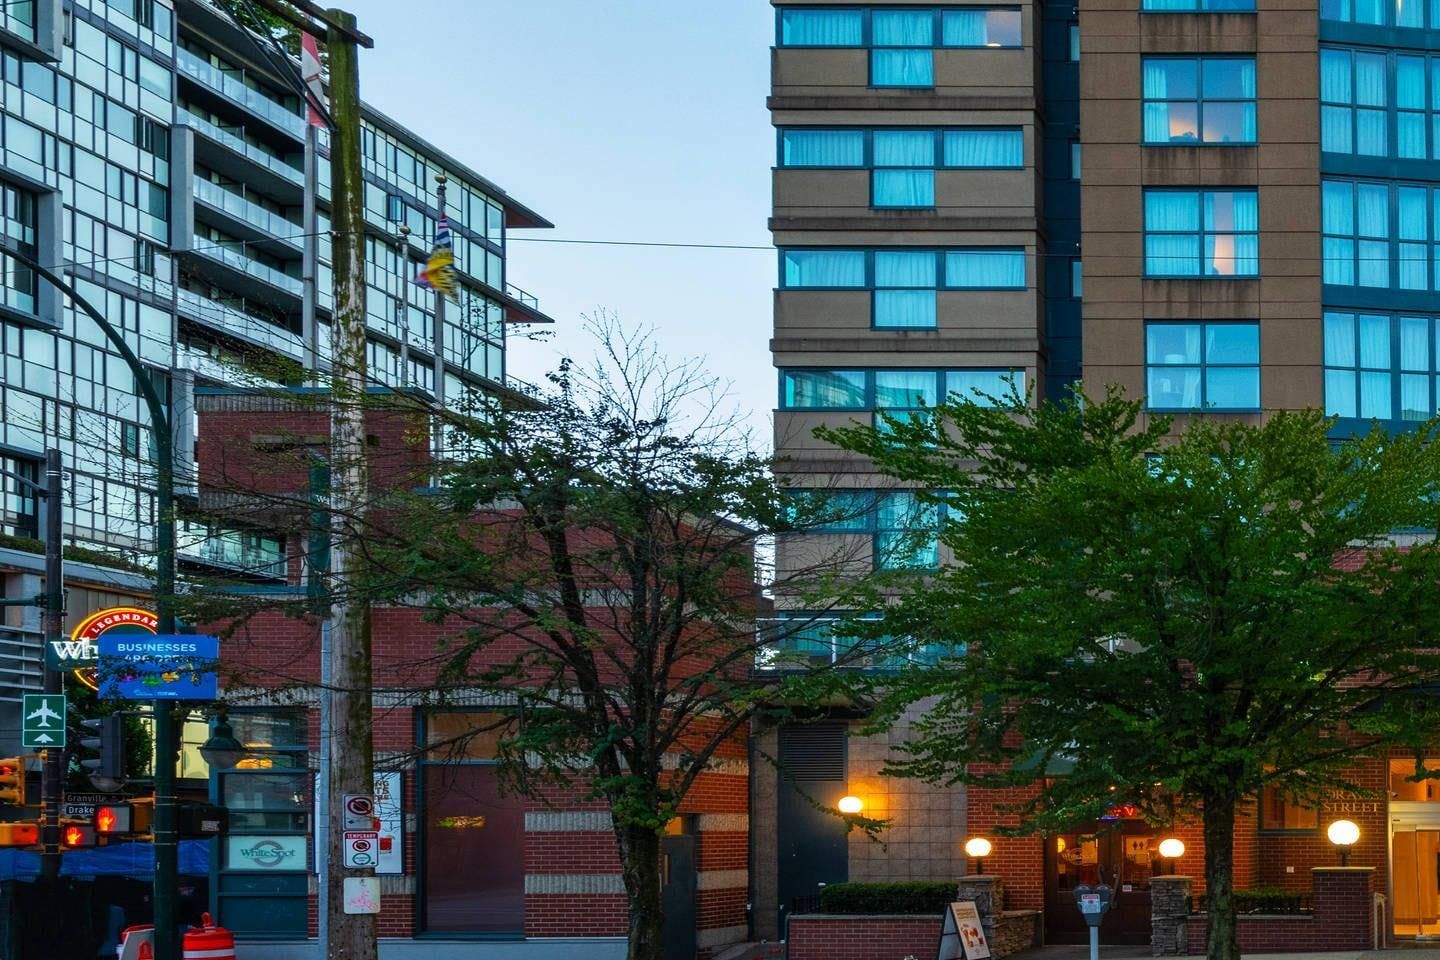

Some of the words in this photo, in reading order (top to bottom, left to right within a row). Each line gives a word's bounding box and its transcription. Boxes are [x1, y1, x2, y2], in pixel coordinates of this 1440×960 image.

[91, 613, 159, 634] LEGENDAR
[50, 636, 99, 660] Wh
[117, 643, 197, 652] BUSINESSES
[1327, 789, 1379, 800] DRA
[68, 806, 95, 814] Drake
[1321, 802, 1378, 812] STREET
